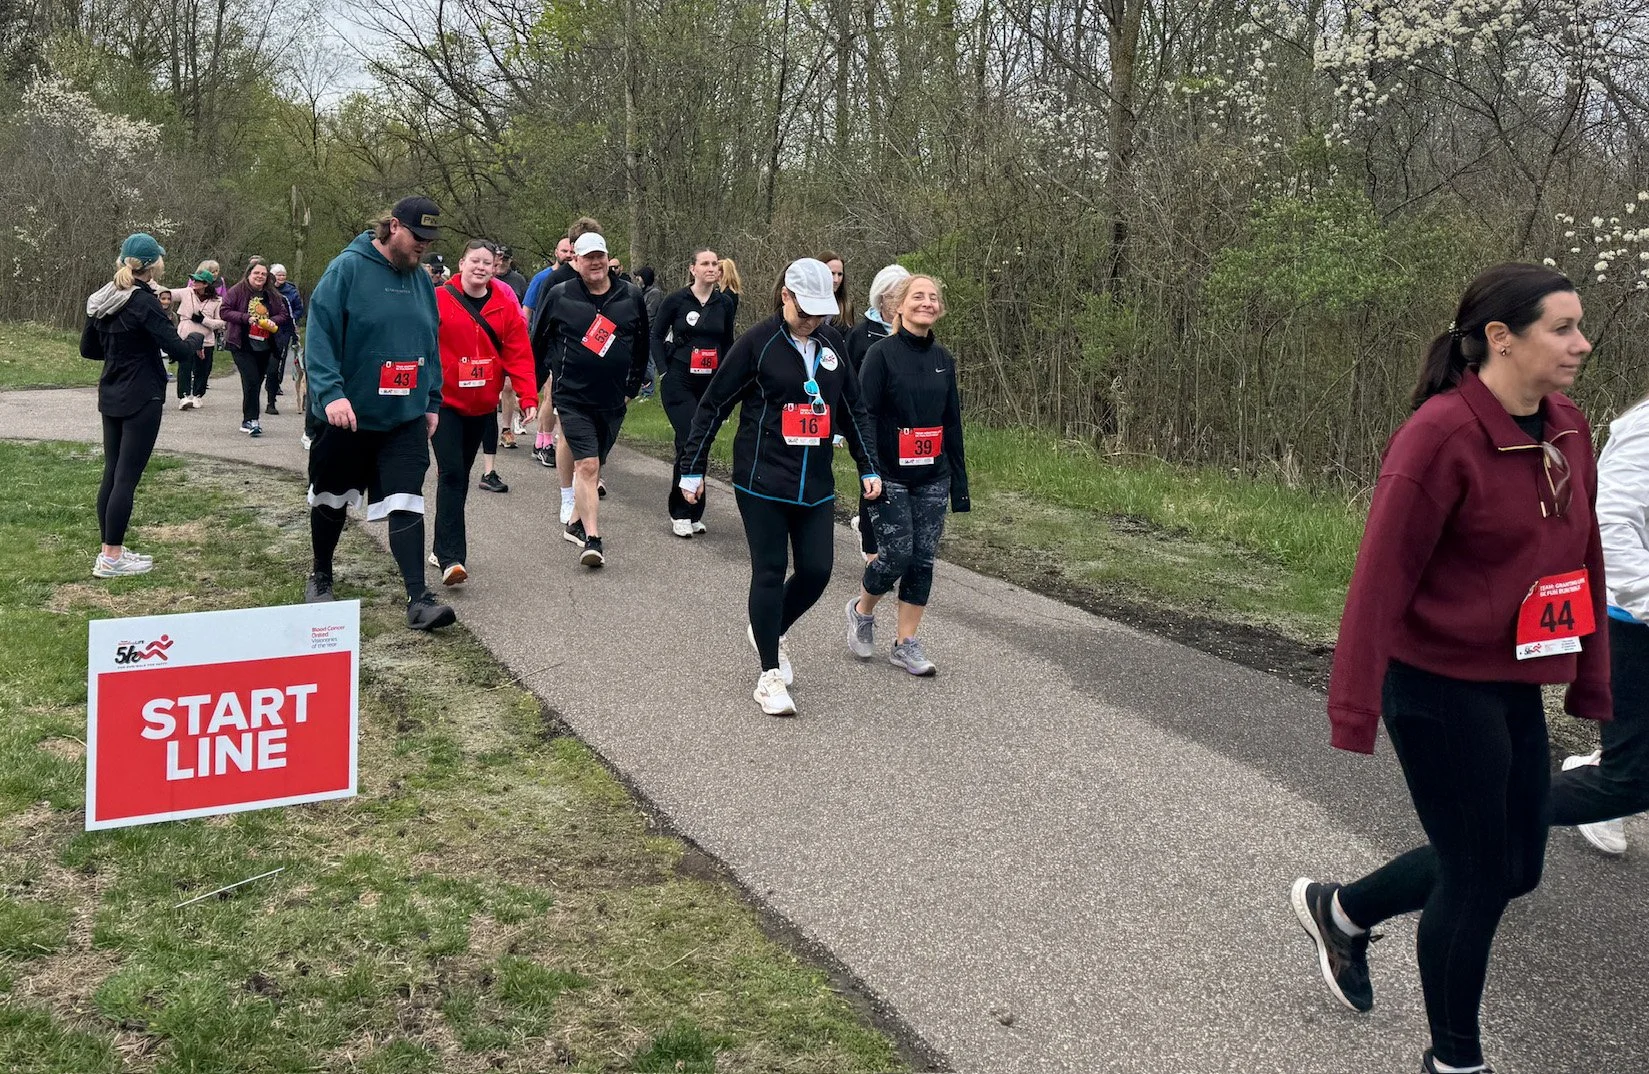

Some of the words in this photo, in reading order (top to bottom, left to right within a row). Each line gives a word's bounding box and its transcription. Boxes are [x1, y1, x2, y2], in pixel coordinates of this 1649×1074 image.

[394, 373, 410, 386] 43
[471, 367, 484, 378] 41
[799, 418, 818, 434] 16
[914, 440, 932, 455] 39
[1541, 600, 1575, 632] 44
[140, 683, 318, 740] START
[166, 728, 287, 781] LINE
